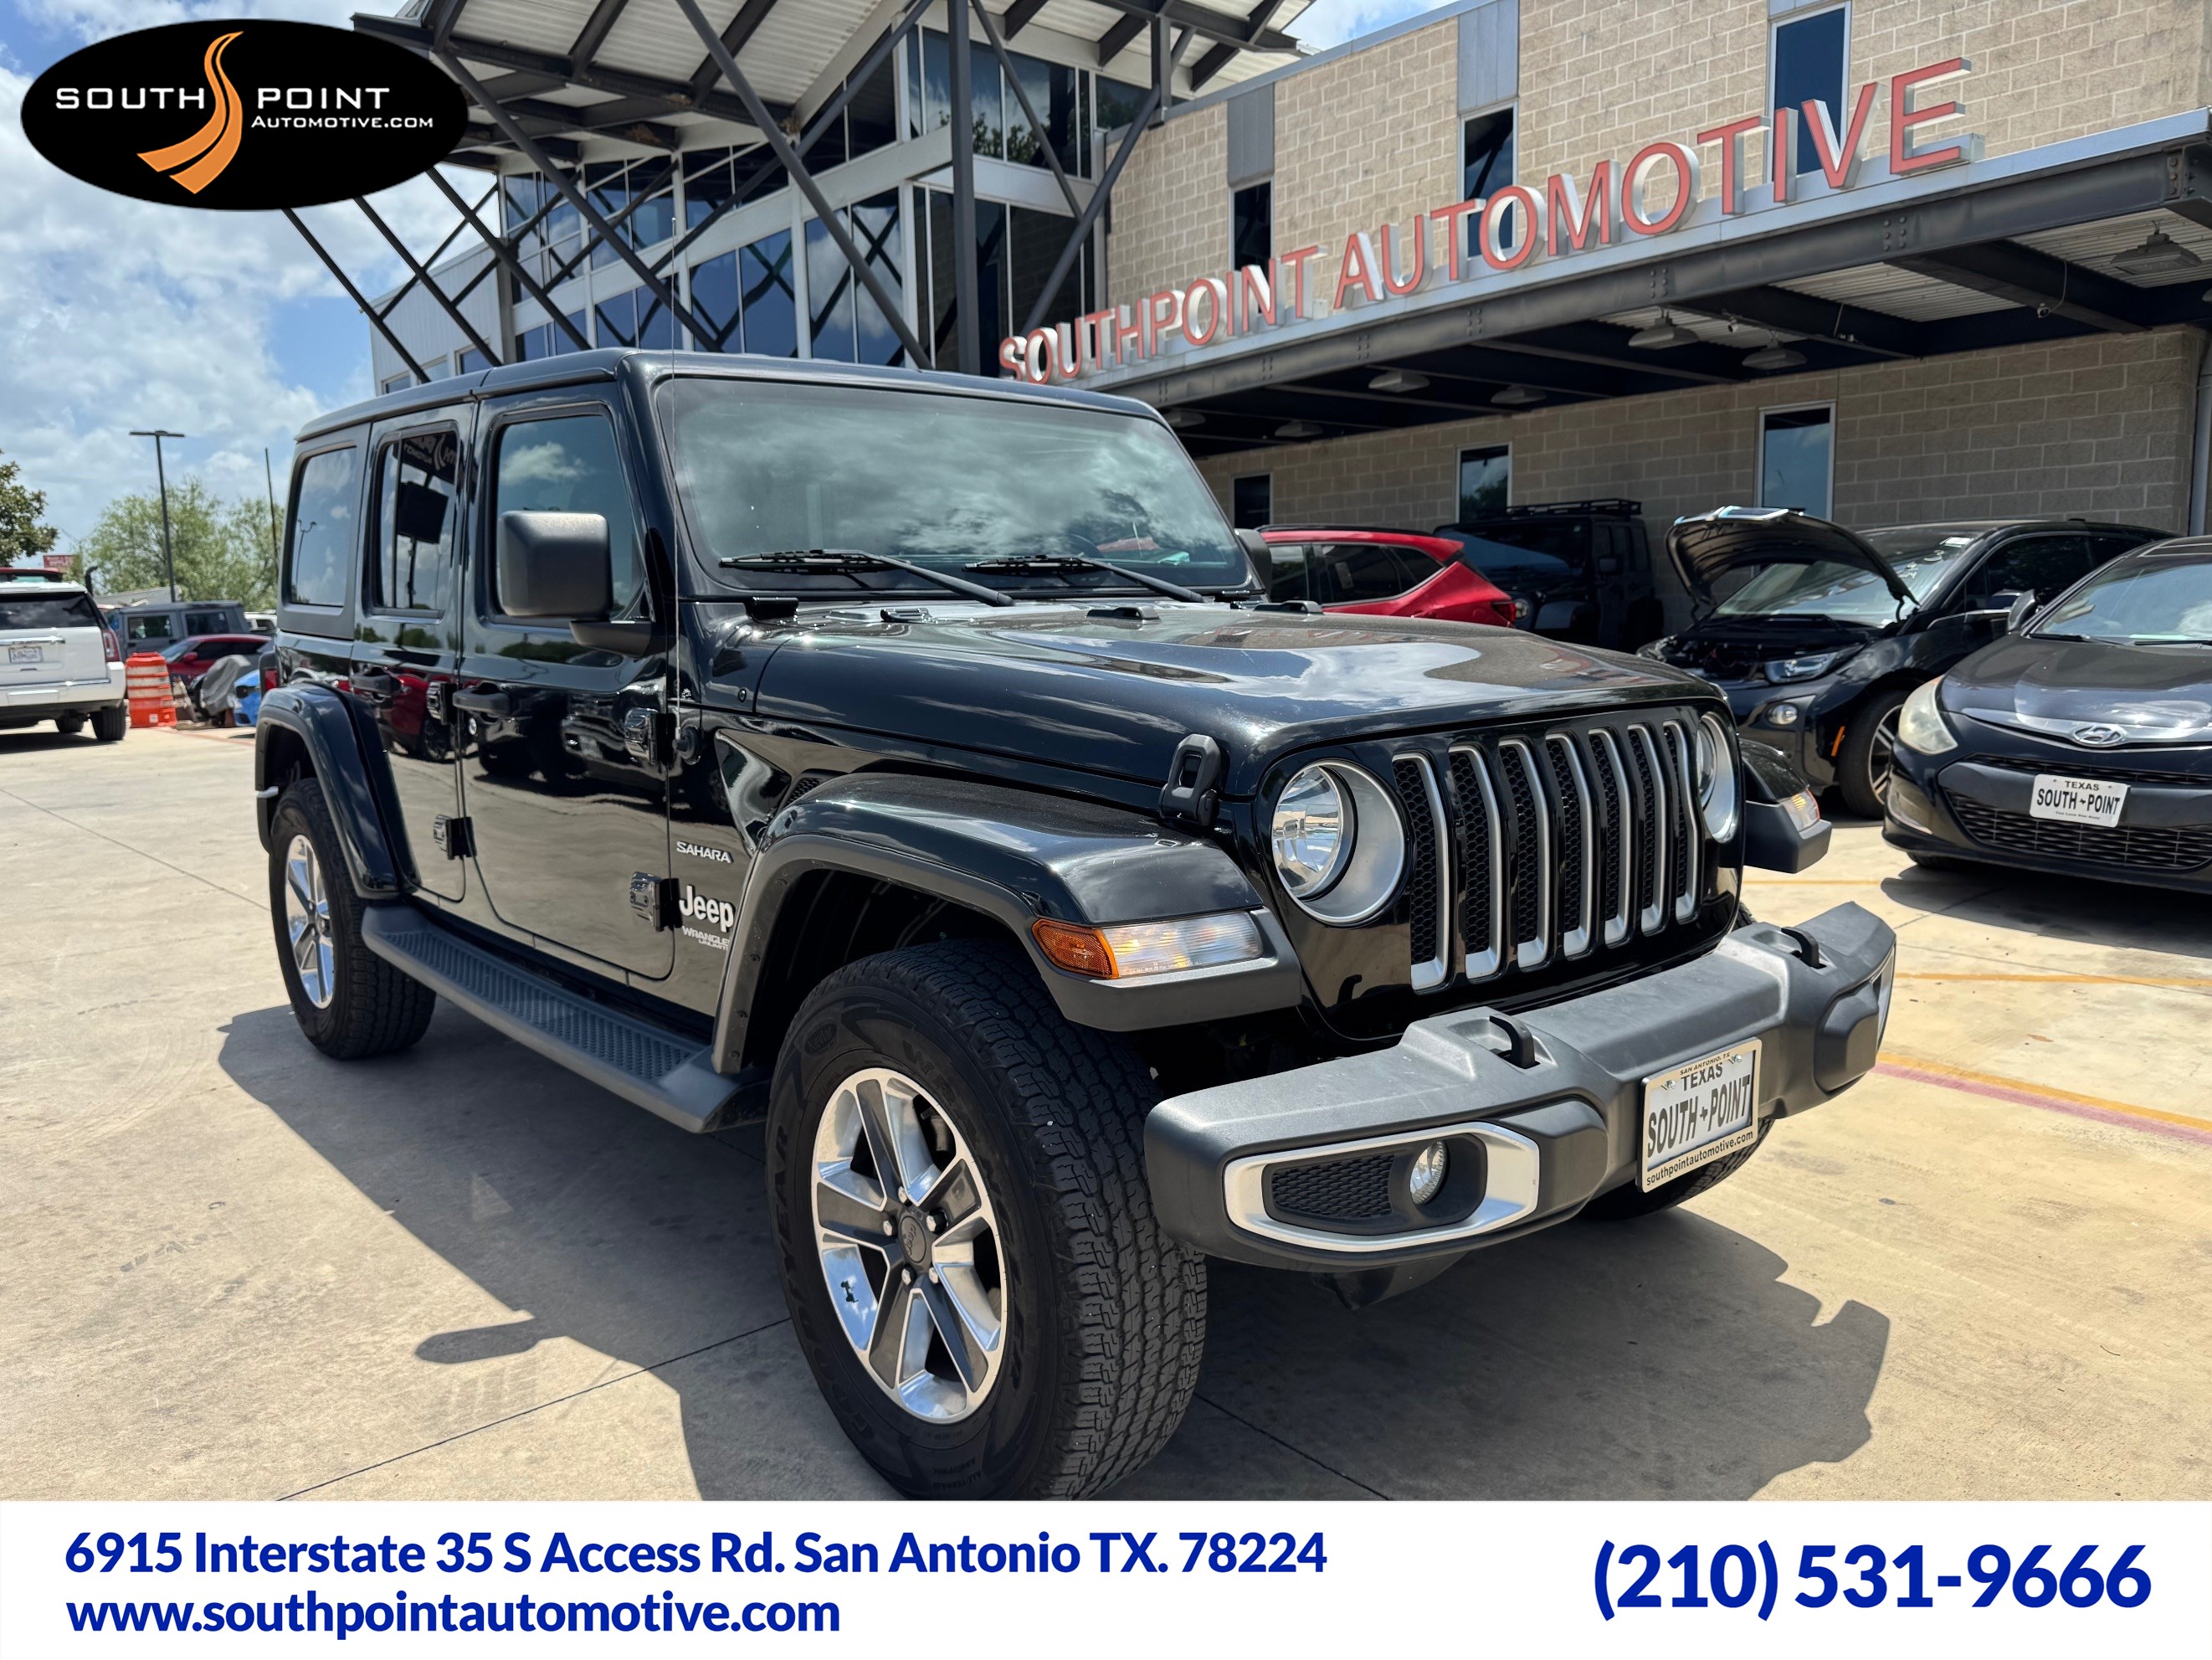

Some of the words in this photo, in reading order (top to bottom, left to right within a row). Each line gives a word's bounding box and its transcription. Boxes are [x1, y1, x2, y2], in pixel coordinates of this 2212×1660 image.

[999, 245, 1327, 385] SOUTHPOINT
[1334, 57, 1972, 309] AUTOMOTIVE
[2065, 780, 2099, 791] TEXAS
[2036, 788, 2077, 809] SOUTH
[2086, 794, 2120, 815] POINT
[676, 840, 733, 863] SAHARA
[679, 885, 734, 933] Jeep
[682, 925, 730, 946] WRANGLE
[1680, 1066, 1692, 1076] SAN
[1681, 1062, 1723, 1091] TEXAS
[1647, 1096, 1698, 1158] SOUTH
[1707, 1074, 1751, 1132] POINT
[1646, 1130, 1753, 1186] southpointautomotive.com
[906, 1224, 917, 1256] Jeep
